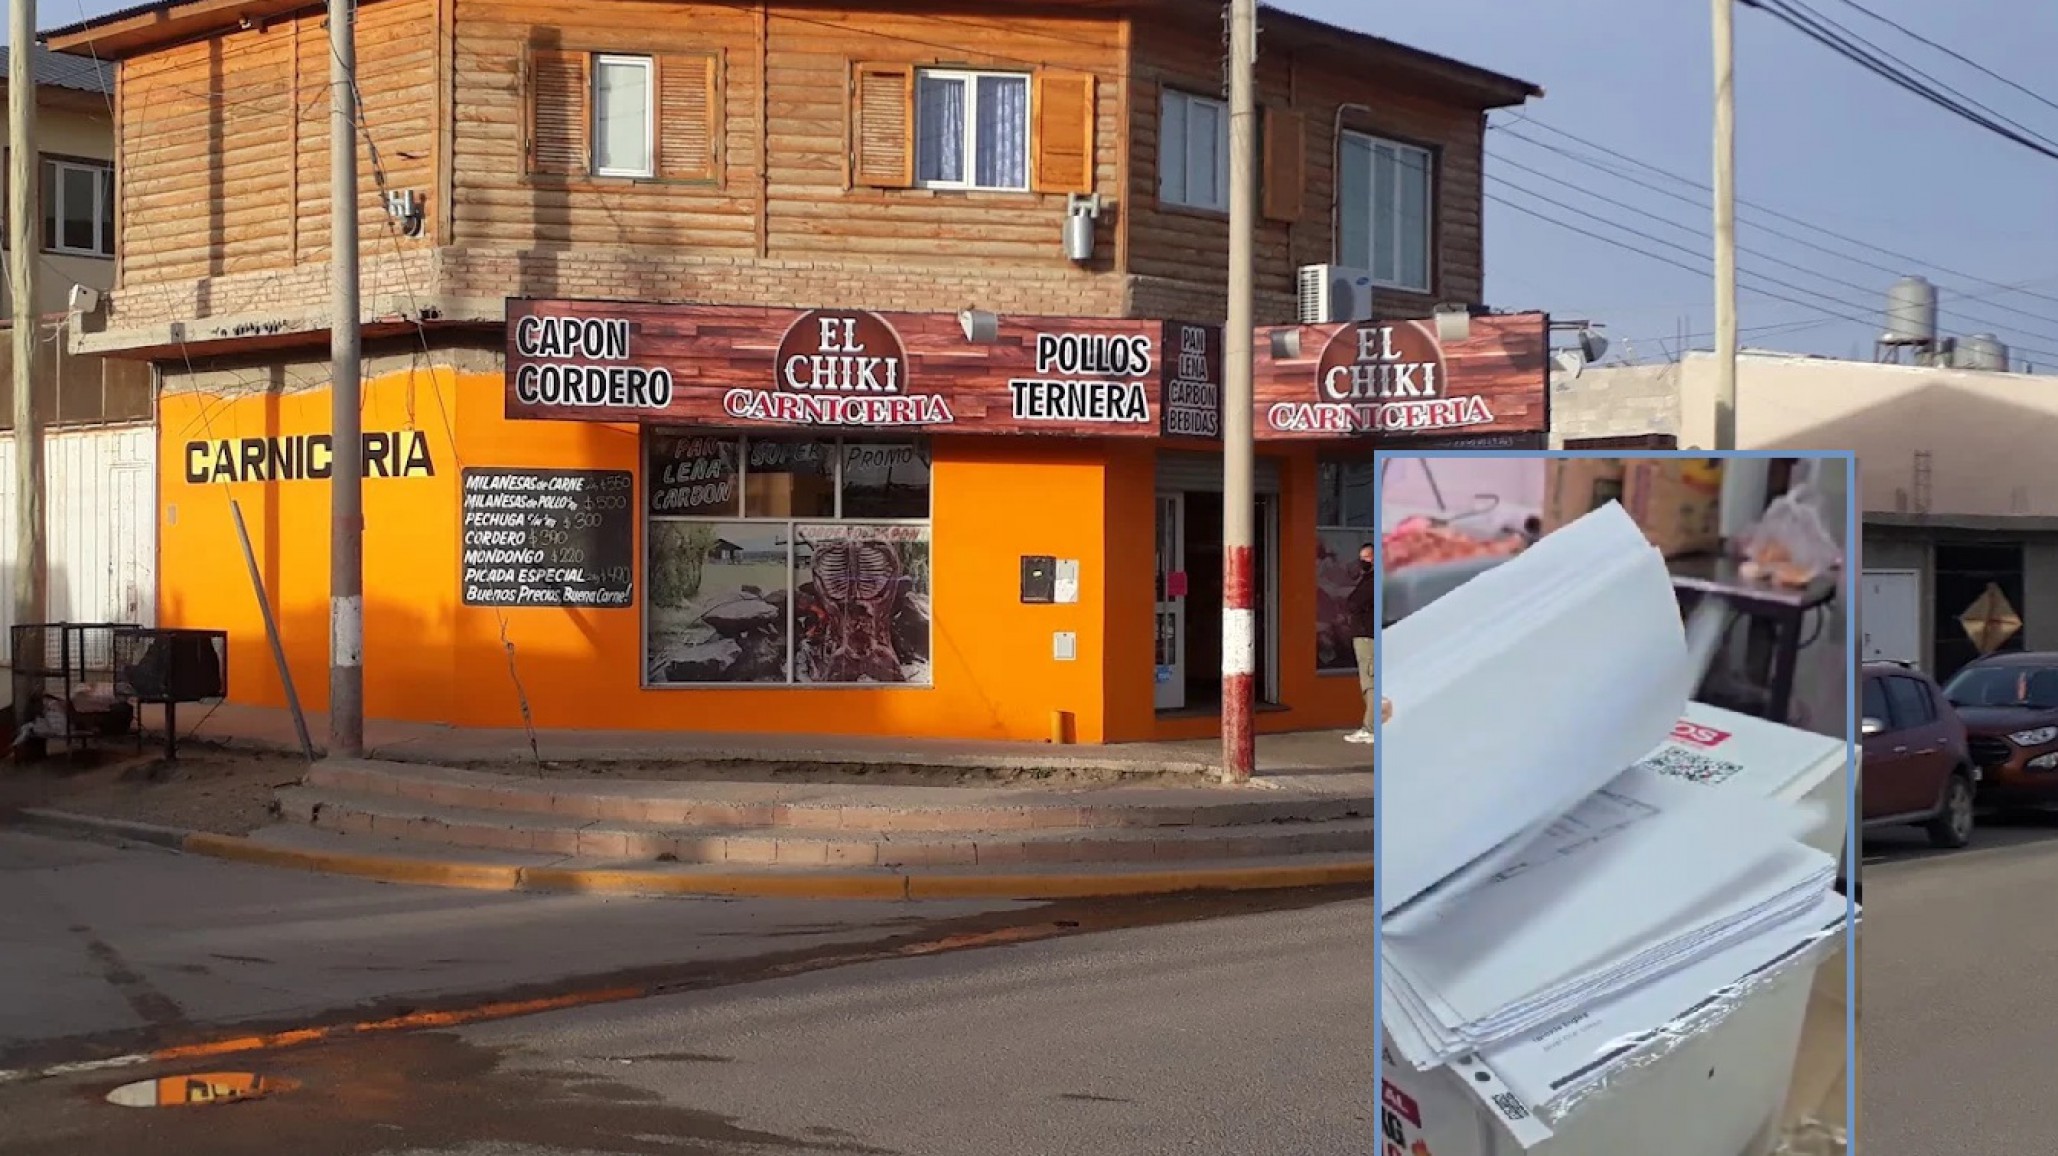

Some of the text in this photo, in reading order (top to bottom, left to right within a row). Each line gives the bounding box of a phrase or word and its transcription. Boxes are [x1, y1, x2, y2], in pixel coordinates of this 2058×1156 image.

[517, 316, 630, 359] CAPON
[818, 317, 864, 352] EL
[1181, 326, 1206, 353] PAN
[1357, 327, 1402, 361] EL
[1036, 333, 1151, 375] POLLOS
[517, 365, 673, 408] CORDERO
[784, 354, 899, 392] CHIKI
[1325, 362, 1437, 399] CHIKI
[724, 388, 954, 425] CARNICERIA
[1009, 378, 1150, 422] TERNERA
[1169, 379, 1217, 410] CARBON
[1168, 407, 1218, 434] BEBIDAS
[1268, 395, 1494, 432] CARNICERIA
[185, 430, 436, 484] CARNICRIA
[673, 437, 719, 459] PAN
[847, 447, 913, 470] PROMO
[465, 475, 538, 491] MILANESAS
[548, 477, 585, 491] CARNE
[652, 481, 732, 511] CARBON
[464, 493, 528, 508] MILANESAS
[464, 512, 525, 527] PECHUGA
[464, 530, 526, 546] CORDERO
[464, 548, 545, 565] MONDONGO
[464, 568, 515, 583] PICADA
[517, 568, 586, 583] ESPECIAL
[466, 584, 518, 601] Buenos
[563, 586, 597, 603] Buena
